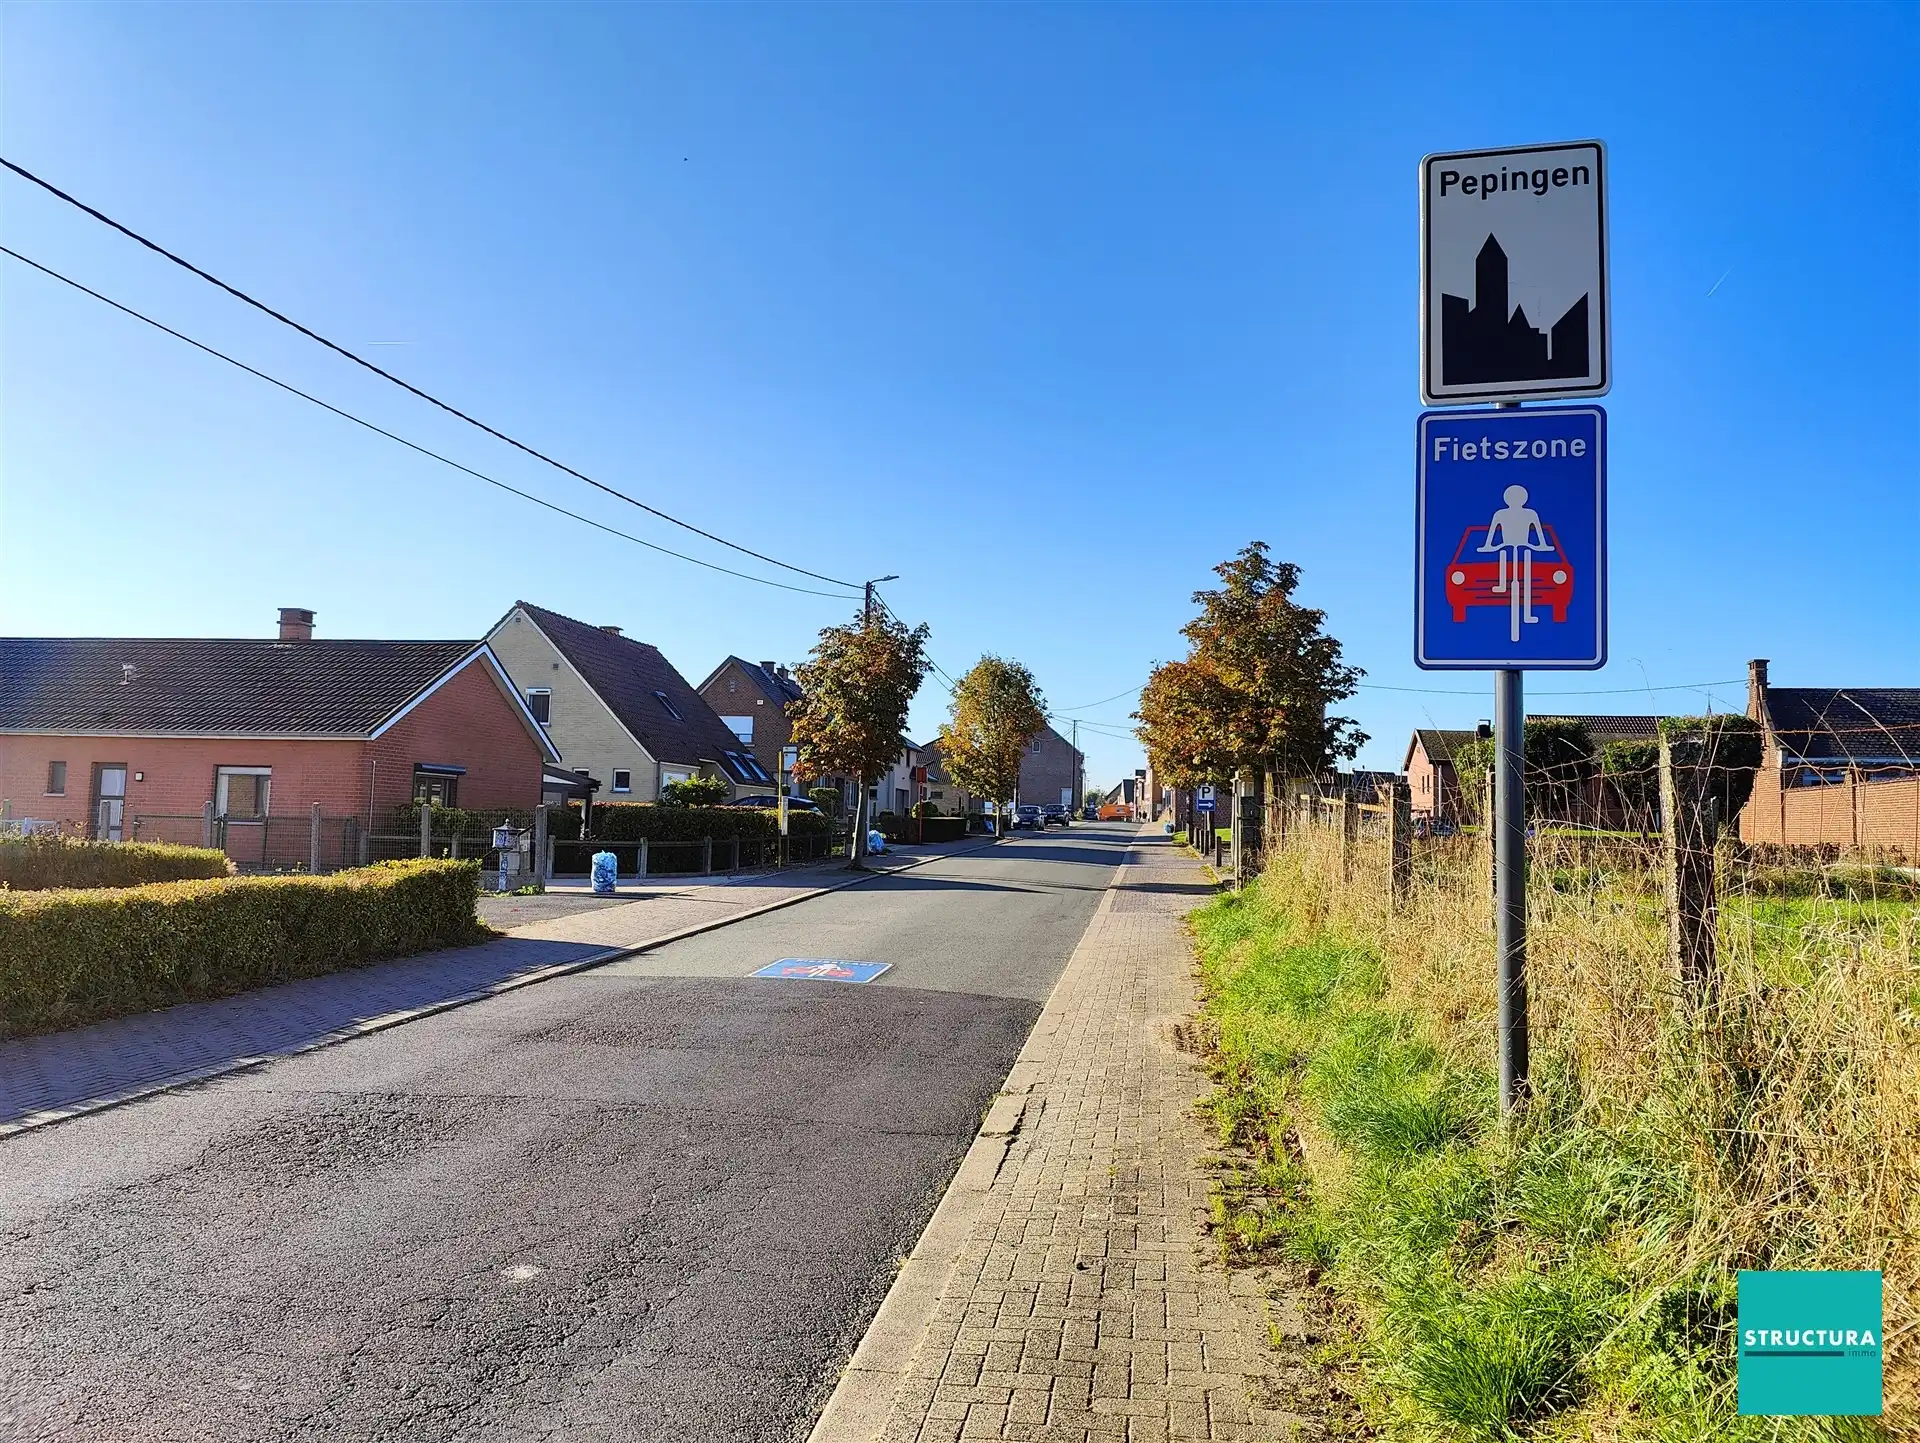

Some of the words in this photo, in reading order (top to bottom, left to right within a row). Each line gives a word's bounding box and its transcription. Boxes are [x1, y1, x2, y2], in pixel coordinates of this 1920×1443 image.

[1440, 166, 1590, 200] Pepingen
[1434, 436, 1586, 462] Fietszone
[1201, 786, 1211, 799] P
